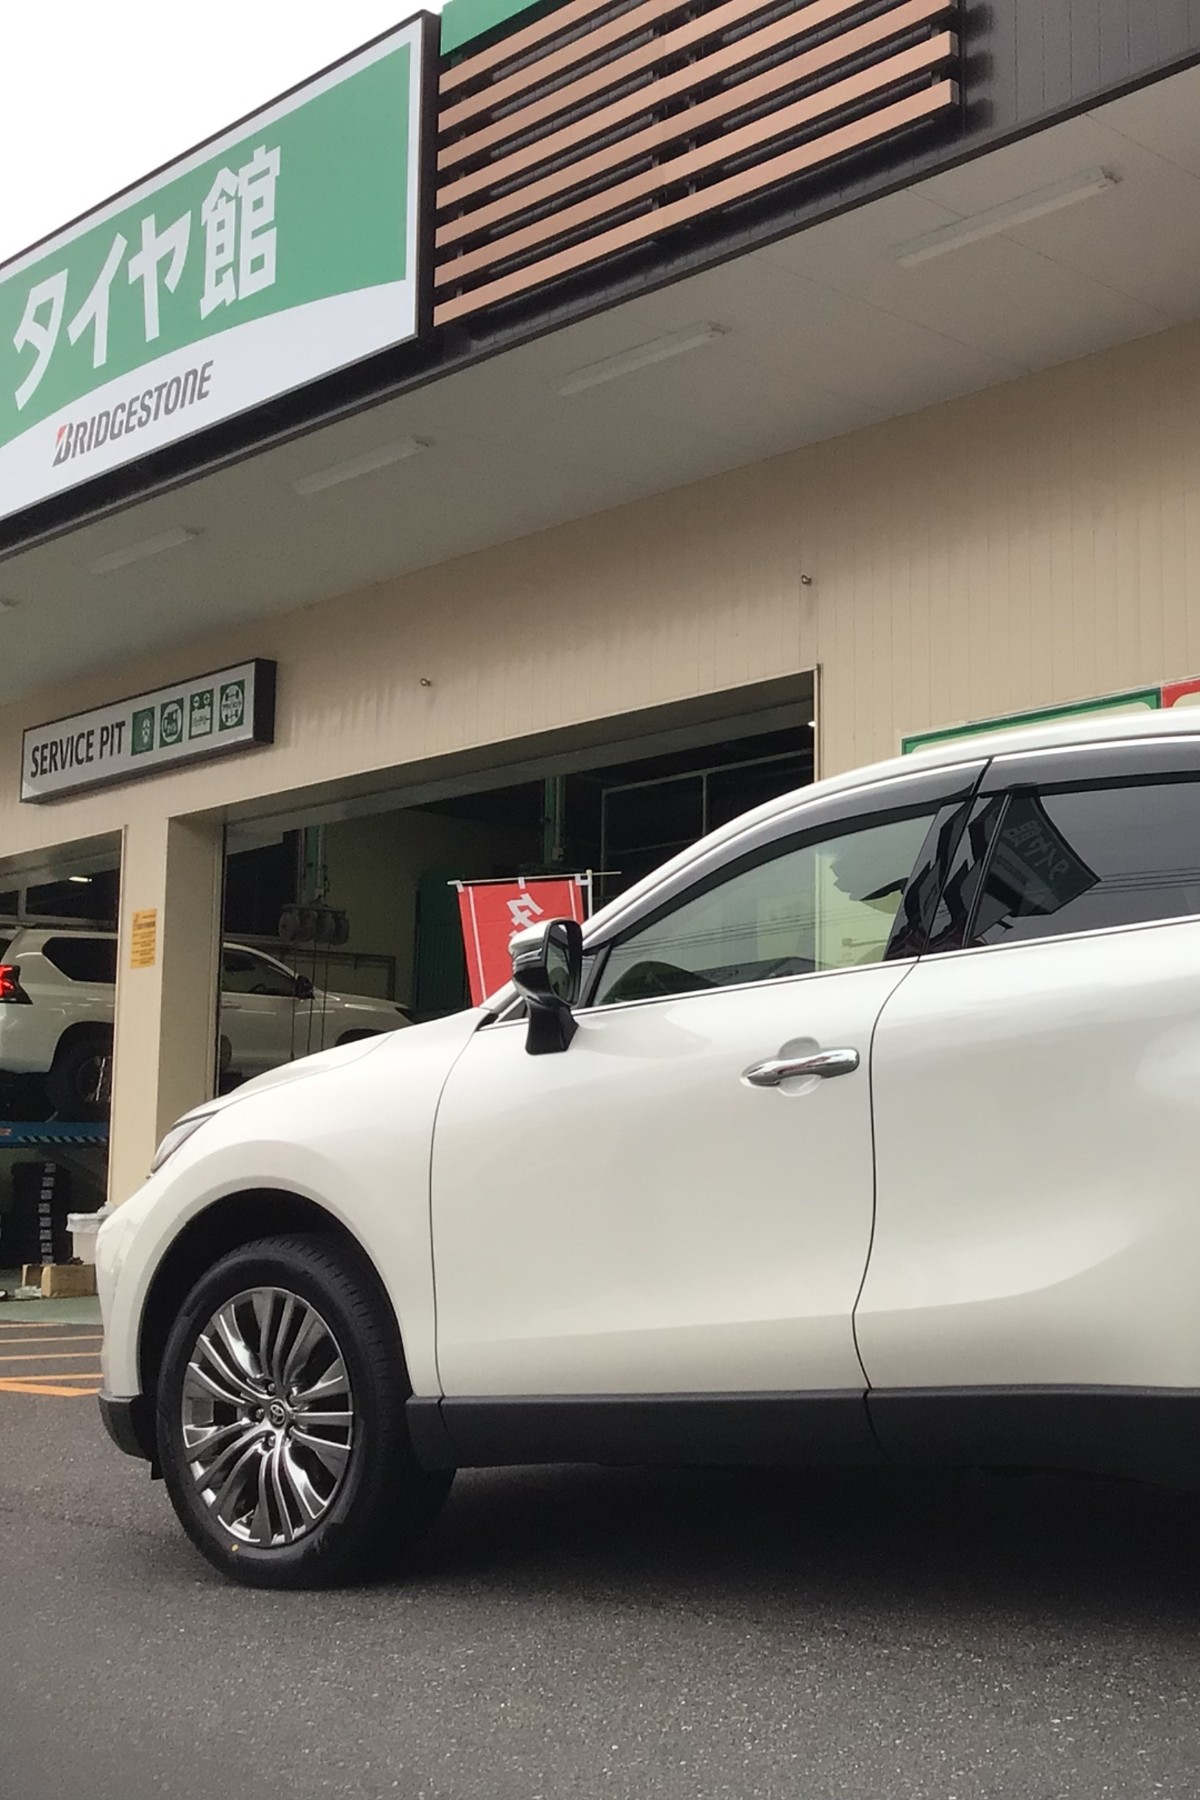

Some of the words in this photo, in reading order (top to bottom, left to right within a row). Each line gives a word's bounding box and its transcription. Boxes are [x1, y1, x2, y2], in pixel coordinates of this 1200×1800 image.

[12, 144, 282, 412] タイヤ館
[52, 359, 215, 467] BRIDGESTONE
[30, 729, 95, 778] SERVICE
[99, 720, 126, 759] PIT
